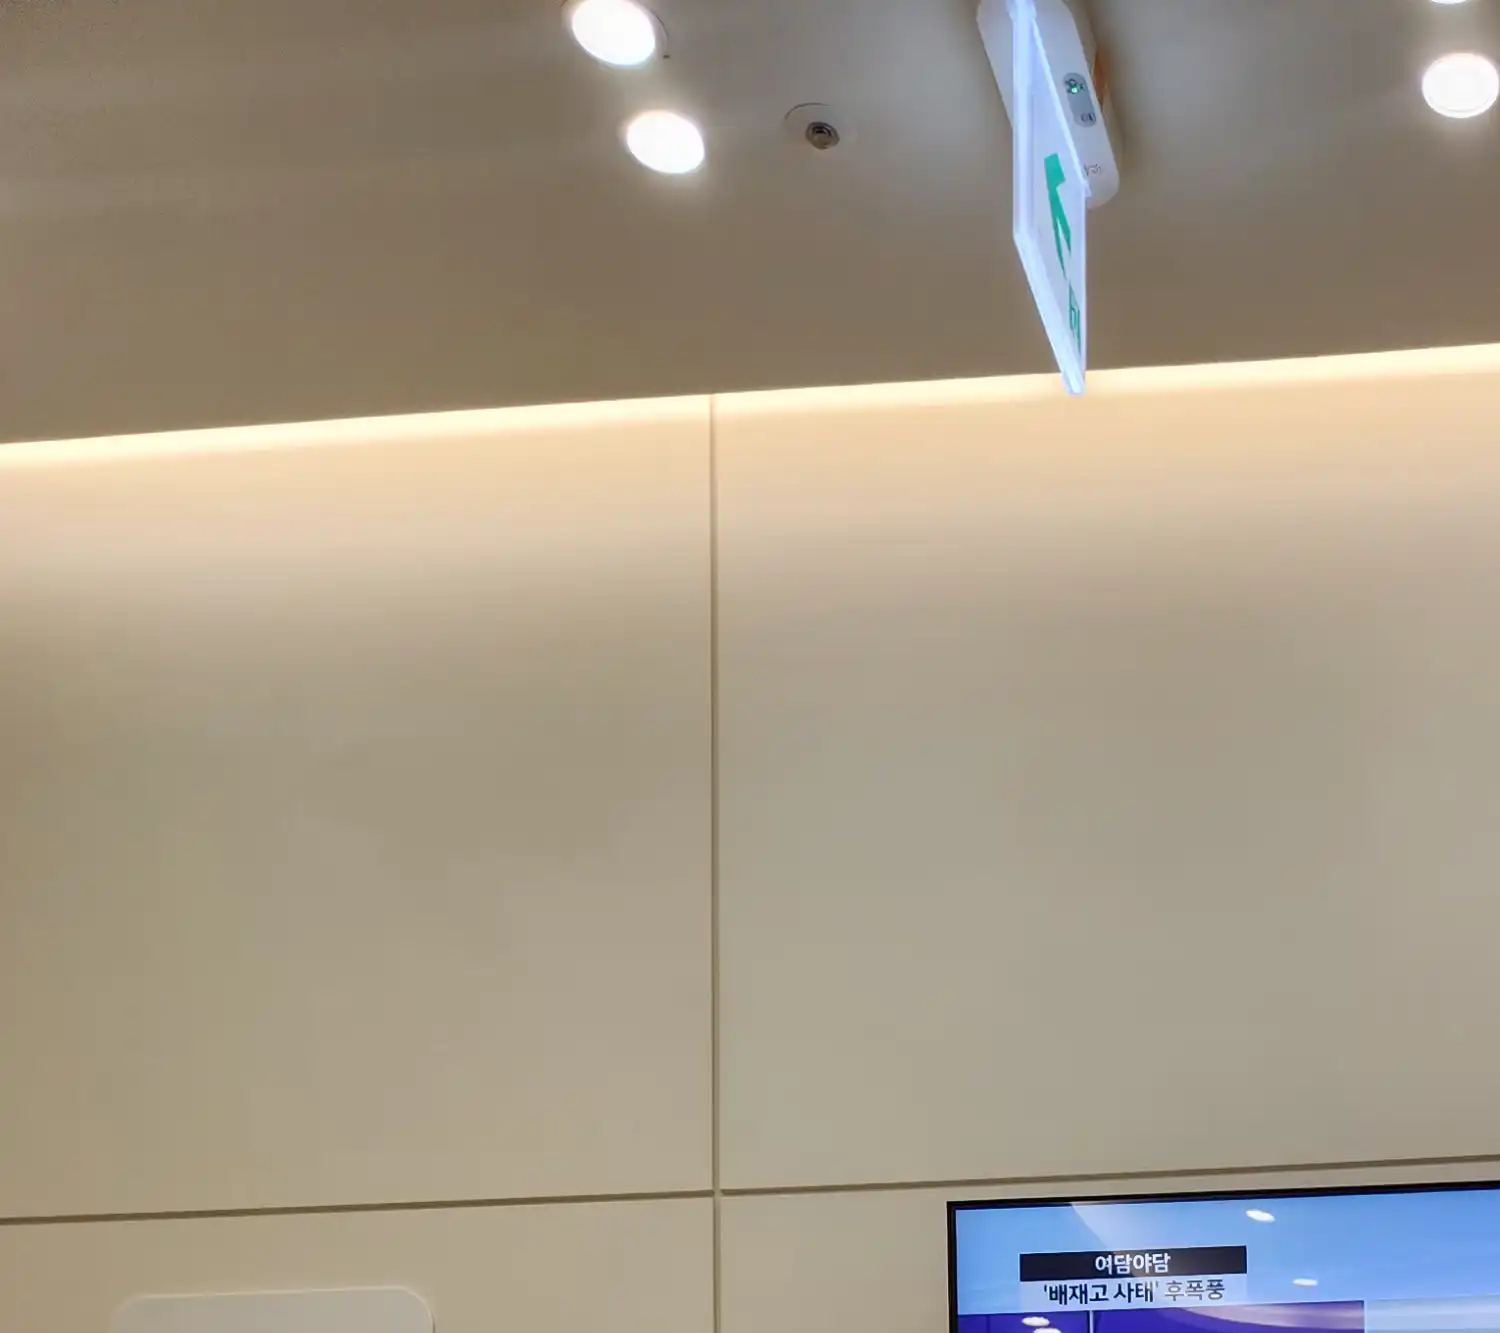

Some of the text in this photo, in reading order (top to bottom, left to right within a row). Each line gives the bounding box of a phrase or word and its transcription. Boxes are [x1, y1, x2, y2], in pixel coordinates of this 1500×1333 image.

[1095, 1253, 1172, 1275] 여담야담
[1044, 1279, 1225, 1306] '배재고 사태' 후폭풍
